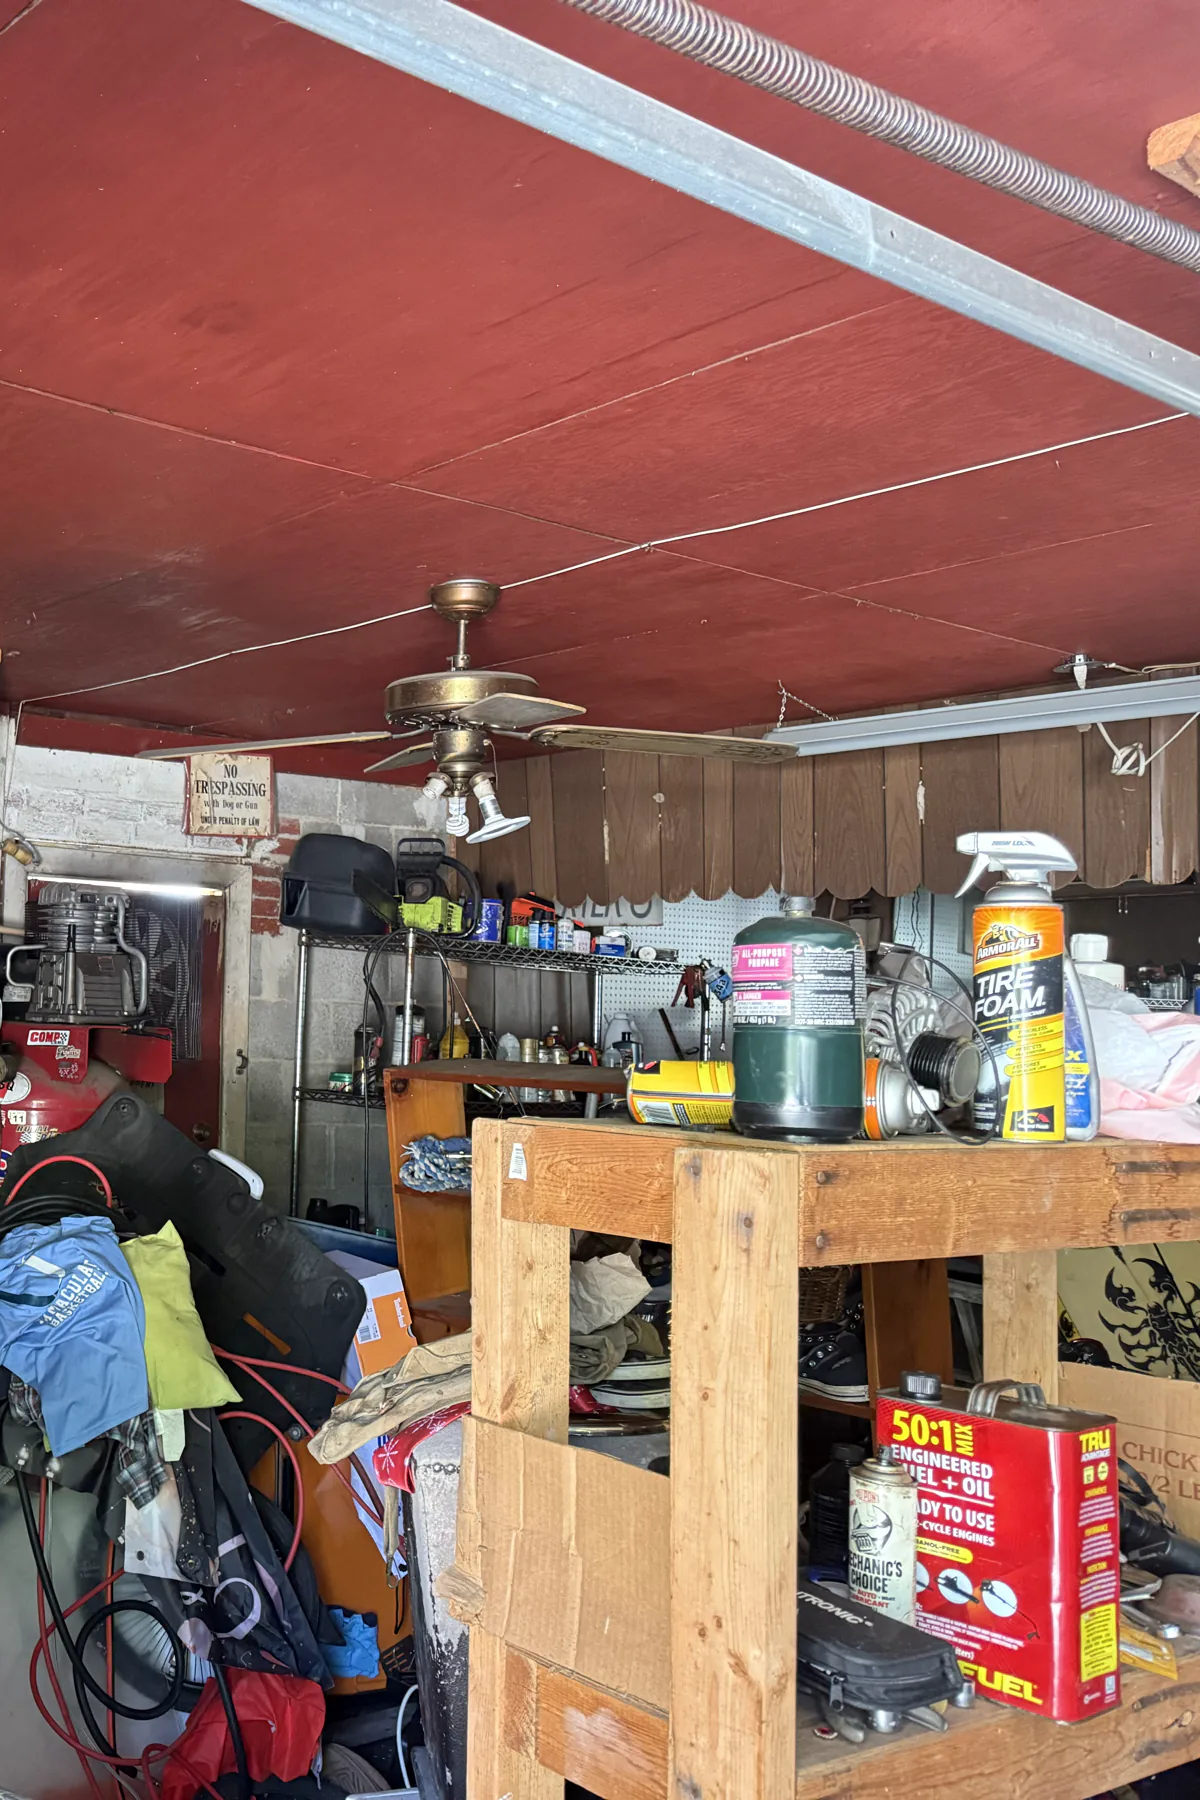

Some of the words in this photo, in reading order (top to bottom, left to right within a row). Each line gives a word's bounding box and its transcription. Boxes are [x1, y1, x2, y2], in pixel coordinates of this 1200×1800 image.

[224, 764, 238, 779] NO
[195, 780, 267, 797] TRESPASSING
[223, 800, 234, 810] Dog
[245, 800, 258, 810] Gun
[219, 816, 240, 826] PENALTY
[241, 817, 247, 825] OF
[249, 817, 260, 826] LAW
[742, 947, 787, 958] ALL-PURPOSE
[748, 958, 779, 968] PROPANE
[977, 966, 1035, 998] TIRE
[974, 986, 1045, 1021] FOAM
[30, 1032, 60, 1043] COMP
[13, 1115, 24, 1123] 11
[50, 1271, 108, 1327] BASKETBAL
[892, 1409, 952, 1452] 50:1
[954, 1423, 974, 1457] MIX
[1079, 1429, 1111, 1454] TRU
[891, 1444, 993, 1479] ENGINEERED
[903, 1463, 938, 1487] UEL
[962, 1477, 995, 1500] OIL
[943, 1504, 963, 1523] TO
[966, 1509, 995, 1532] USE
[952, 1528, 996, 1547] ENGINES
[849, 1551, 903, 1578] ECHANIC'S
[850, 1569, 887, 1594] CHOICE
[857, 1589, 876, 1600] AUTO
